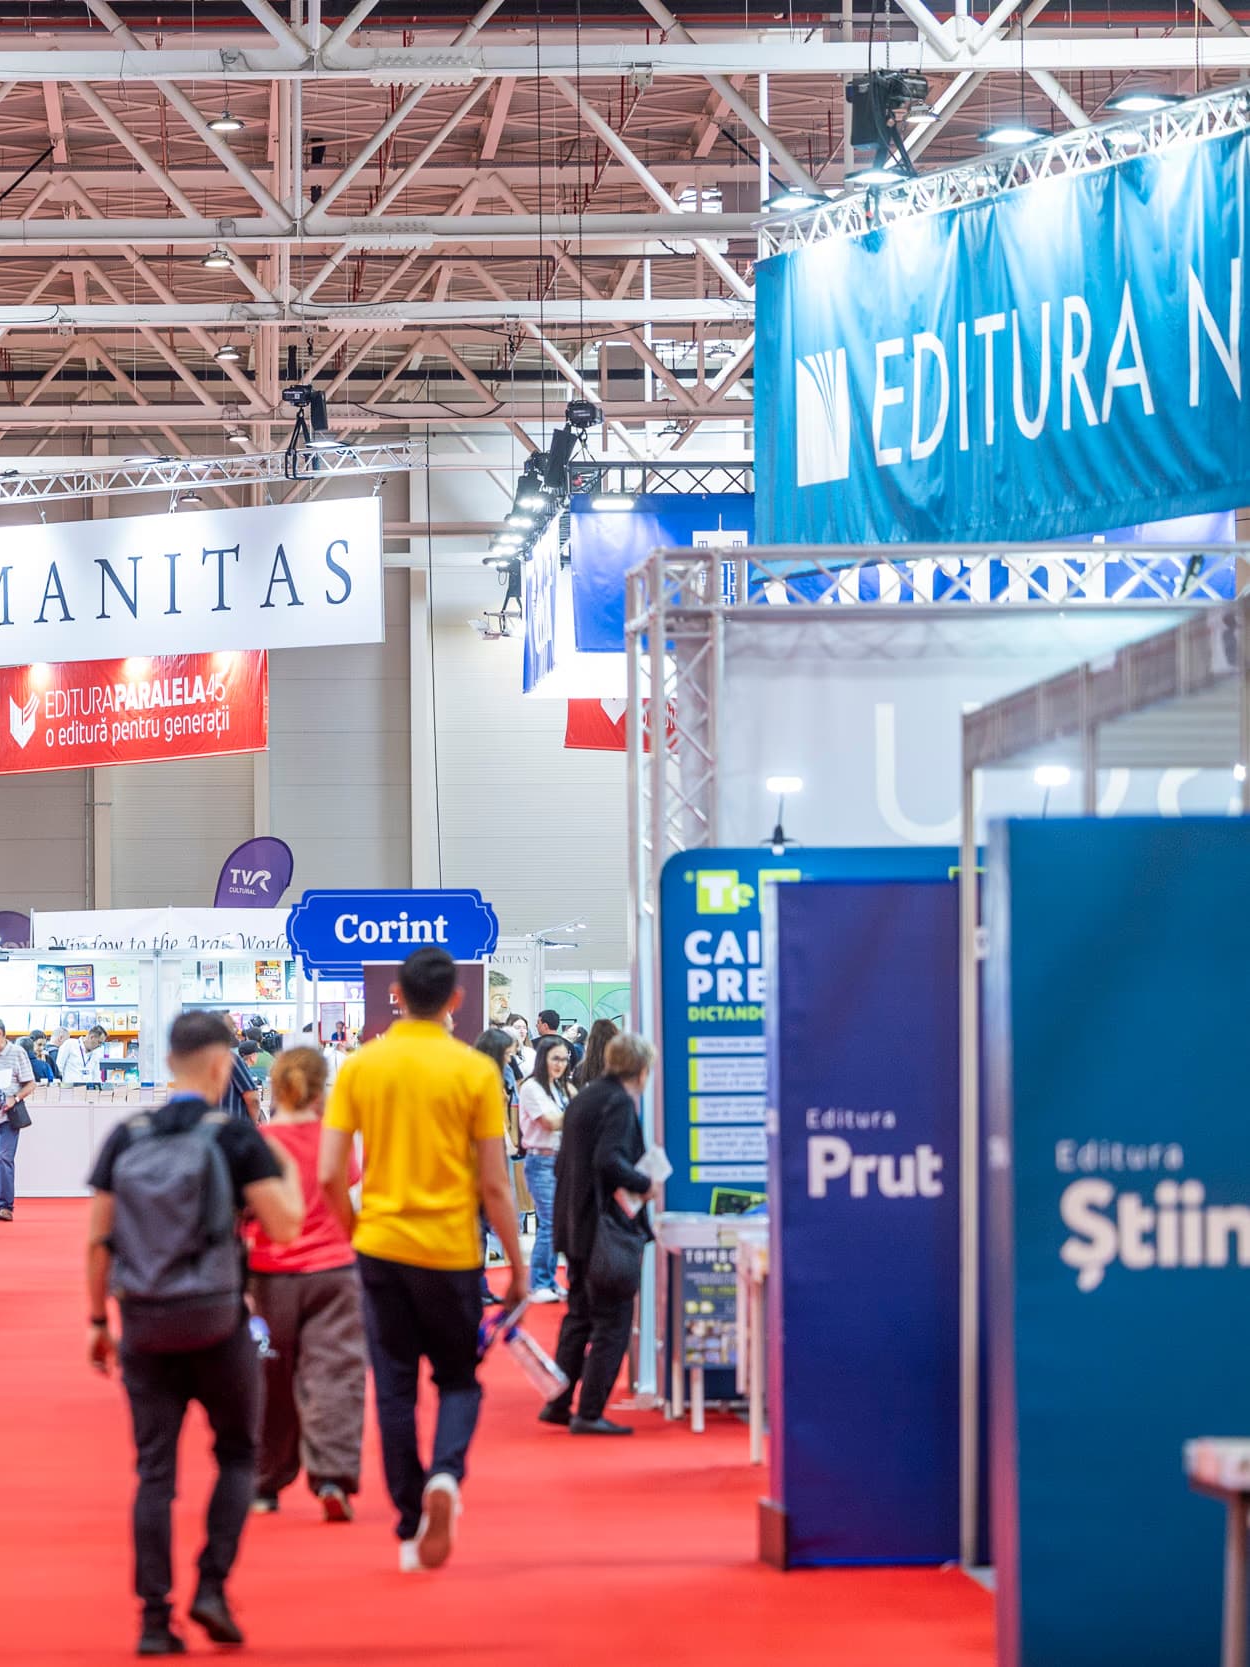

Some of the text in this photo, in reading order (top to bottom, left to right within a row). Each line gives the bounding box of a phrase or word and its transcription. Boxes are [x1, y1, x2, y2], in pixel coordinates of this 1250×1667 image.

[872, 257, 1242, 468] EDITURA N
[46, 705, 230, 747] o editură pentru generații
[229, 887, 256, 896] CULTURAL
[152, 931, 178, 950] the
[335, 911, 449, 944] Corint
[806, 1108, 896, 1129] Editura
[808, 1136, 944, 1199] Prut
[1055, 1138, 1184, 1172] Editura
